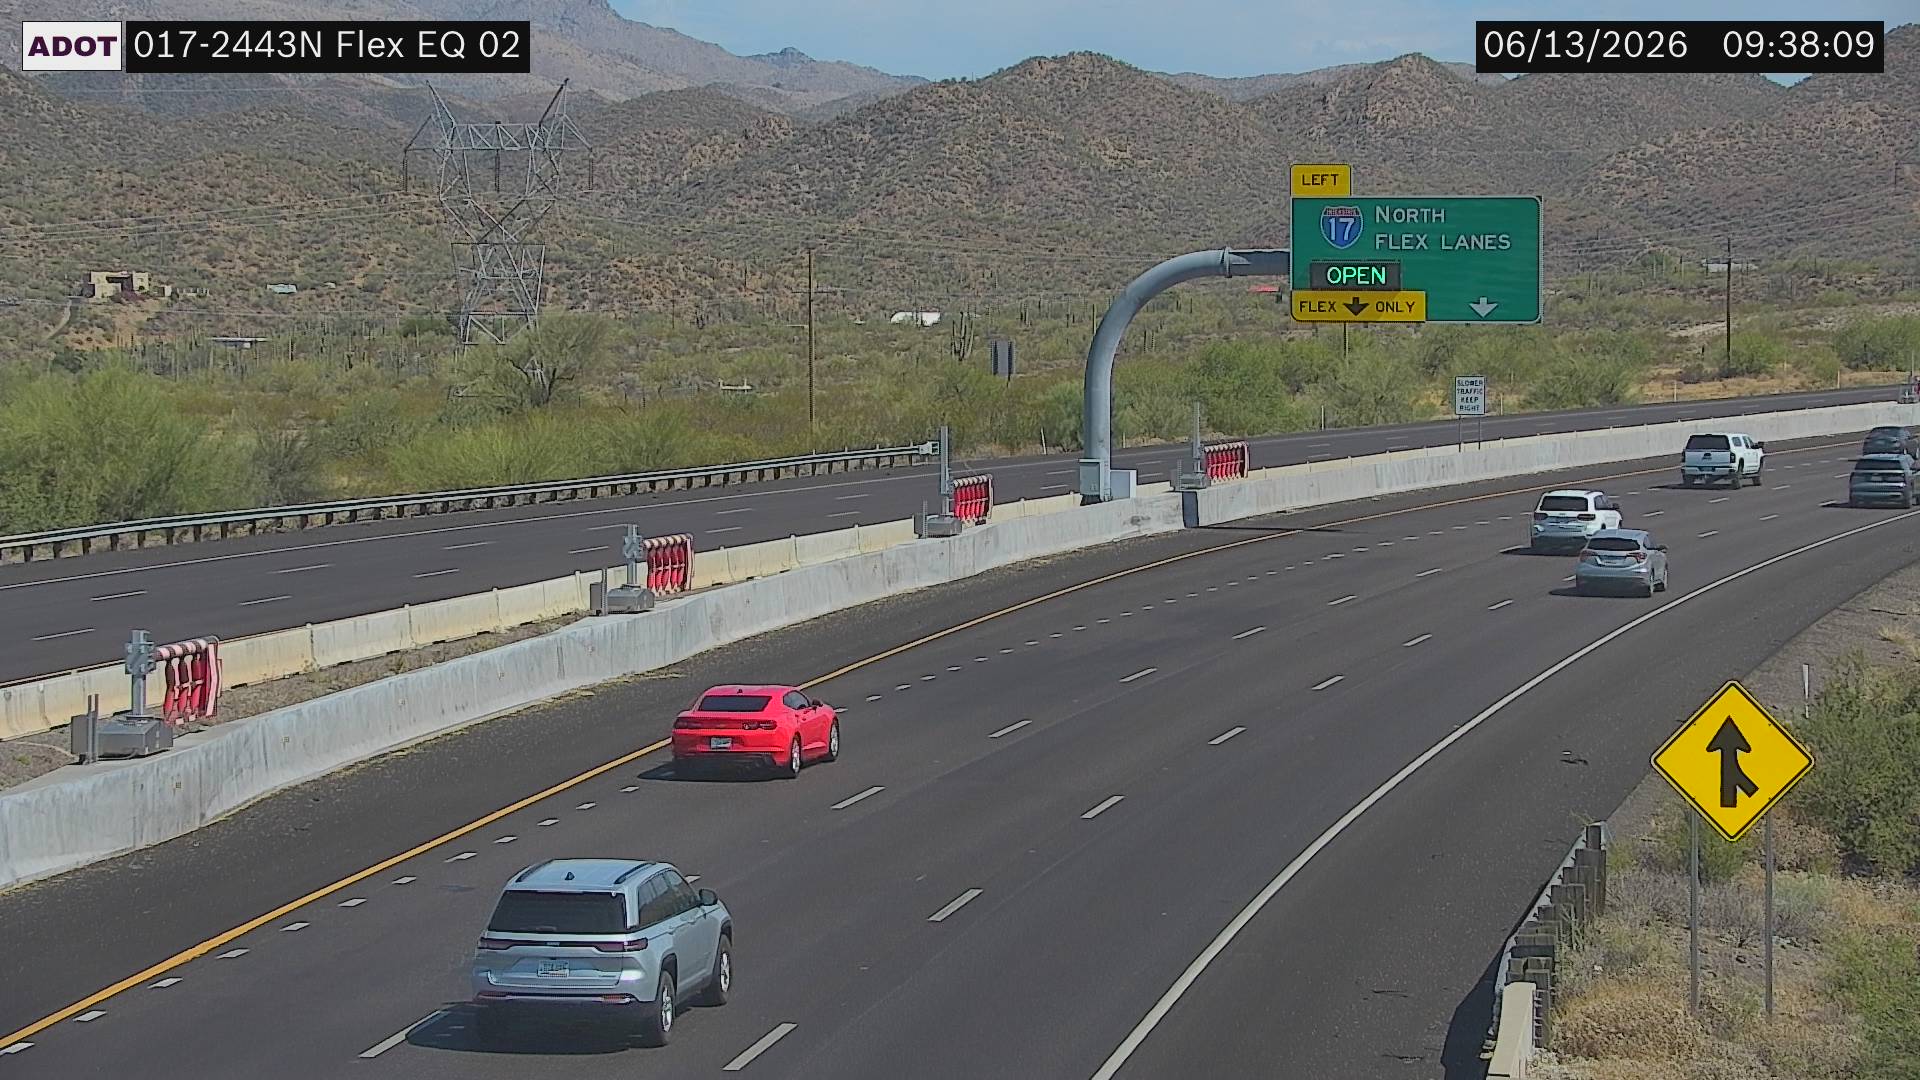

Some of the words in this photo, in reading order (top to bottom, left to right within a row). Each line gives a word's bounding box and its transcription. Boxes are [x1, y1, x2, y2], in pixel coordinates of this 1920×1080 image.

[1302, 174, 1339, 186] LEFT
[1375, 206, 1445, 223] NORTH
[1328, 217, 1355, 241] 17
[1375, 234, 1428, 250] FLEX
[1441, 234, 1511, 250] LANES
[1326, 266, 1386, 285] OPEN
[1299, 301, 1337, 313] FLEX
[1375, 301, 1415, 313] ONLY
